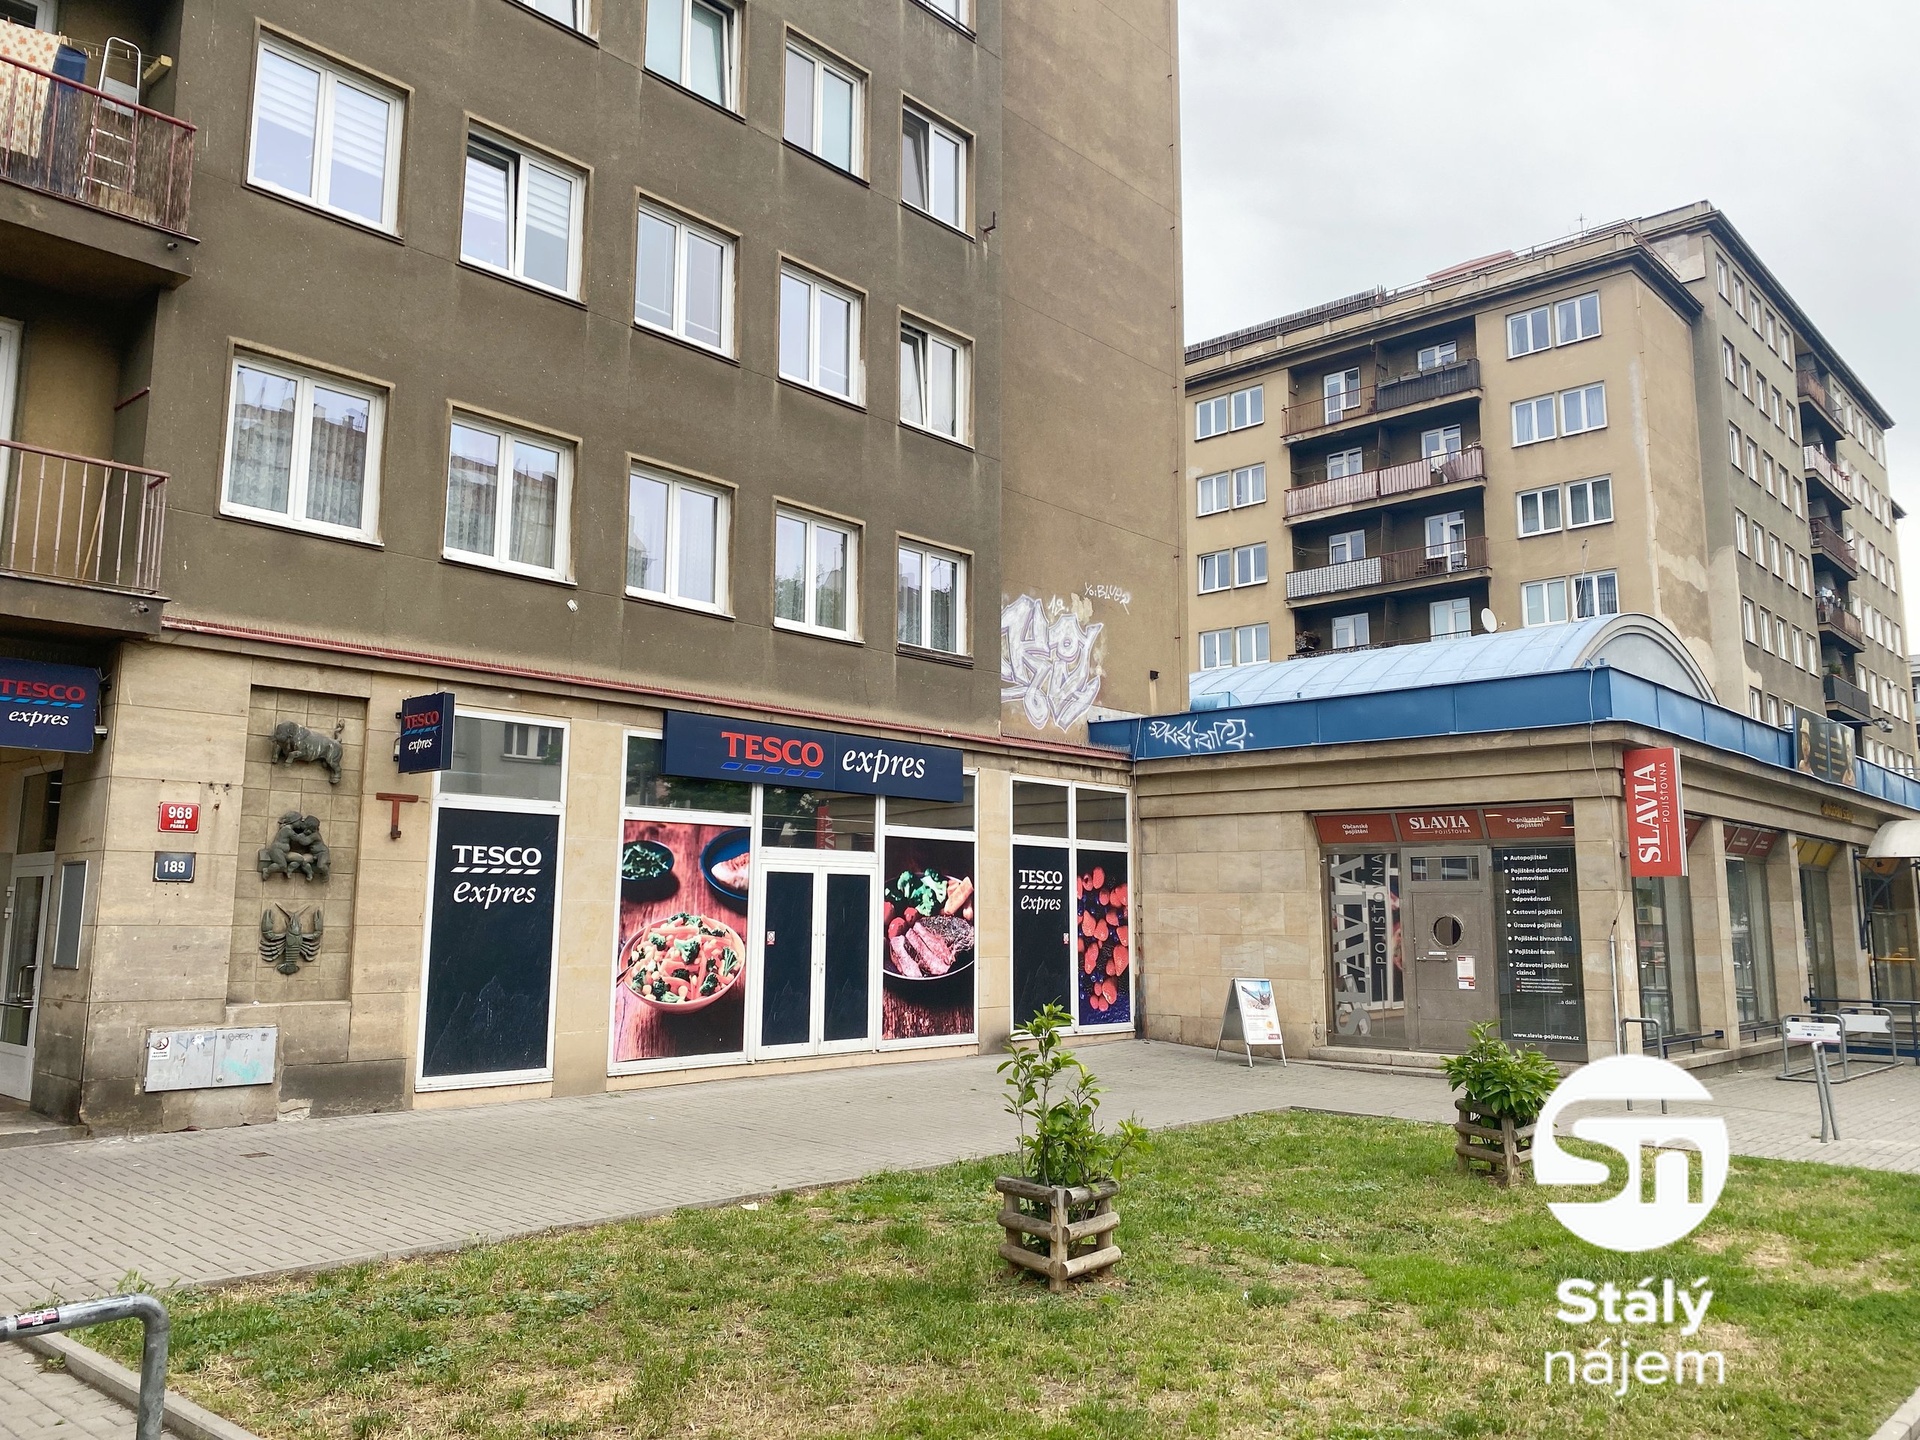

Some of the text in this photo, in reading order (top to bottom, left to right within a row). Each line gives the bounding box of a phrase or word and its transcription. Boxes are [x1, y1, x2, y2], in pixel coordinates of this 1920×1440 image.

[0, 678, 86, 702] TESCO
[8, 710, 70, 727] expres
[404, 711, 440, 729] TESCO
[408, 738, 433, 754] expres
[720, 731, 926, 783] TESCO expres
[168, 806, 192, 819] 968
[1409, 815, 1470, 829] SLAVIA
[1633, 762, 1662, 863] SLAVIA
[452, 844, 542, 866] TESCO
[164, 860, 185, 873] 189
[1018, 869, 1063, 885] TESCO
[453, 881, 537, 910] expres
[1020, 894, 1062, 915] expres
[1371, 854, 1388, 969] POJIŠŤOVNA
[1330, 854, 1372, 1035] SLAVIA
[1513, 1032, 1579, 1040] www.slavia-pojistovna.cz
